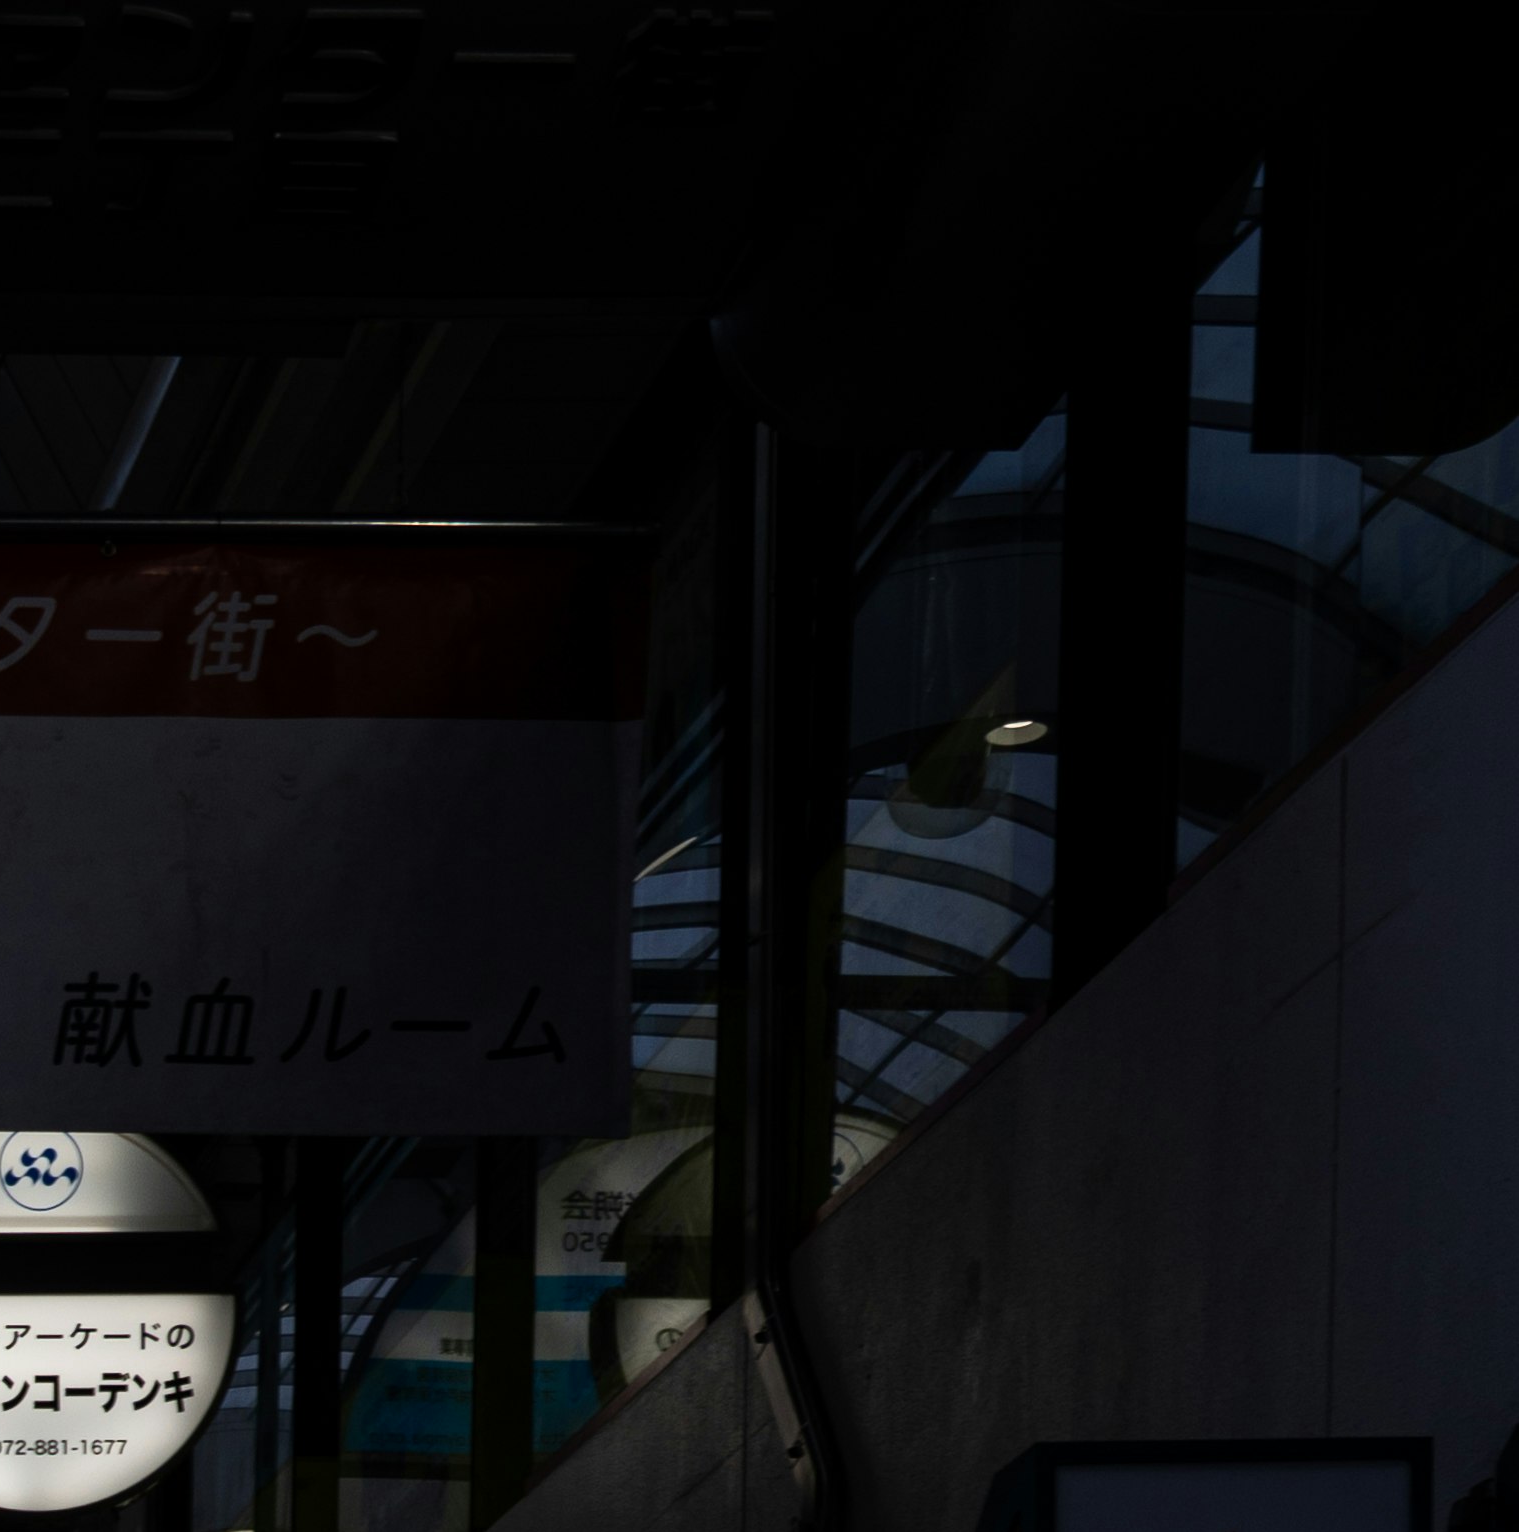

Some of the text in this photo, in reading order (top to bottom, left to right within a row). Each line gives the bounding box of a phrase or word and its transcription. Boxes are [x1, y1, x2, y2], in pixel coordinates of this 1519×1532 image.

[53, 973, 566, 1068] 献血ルーム
